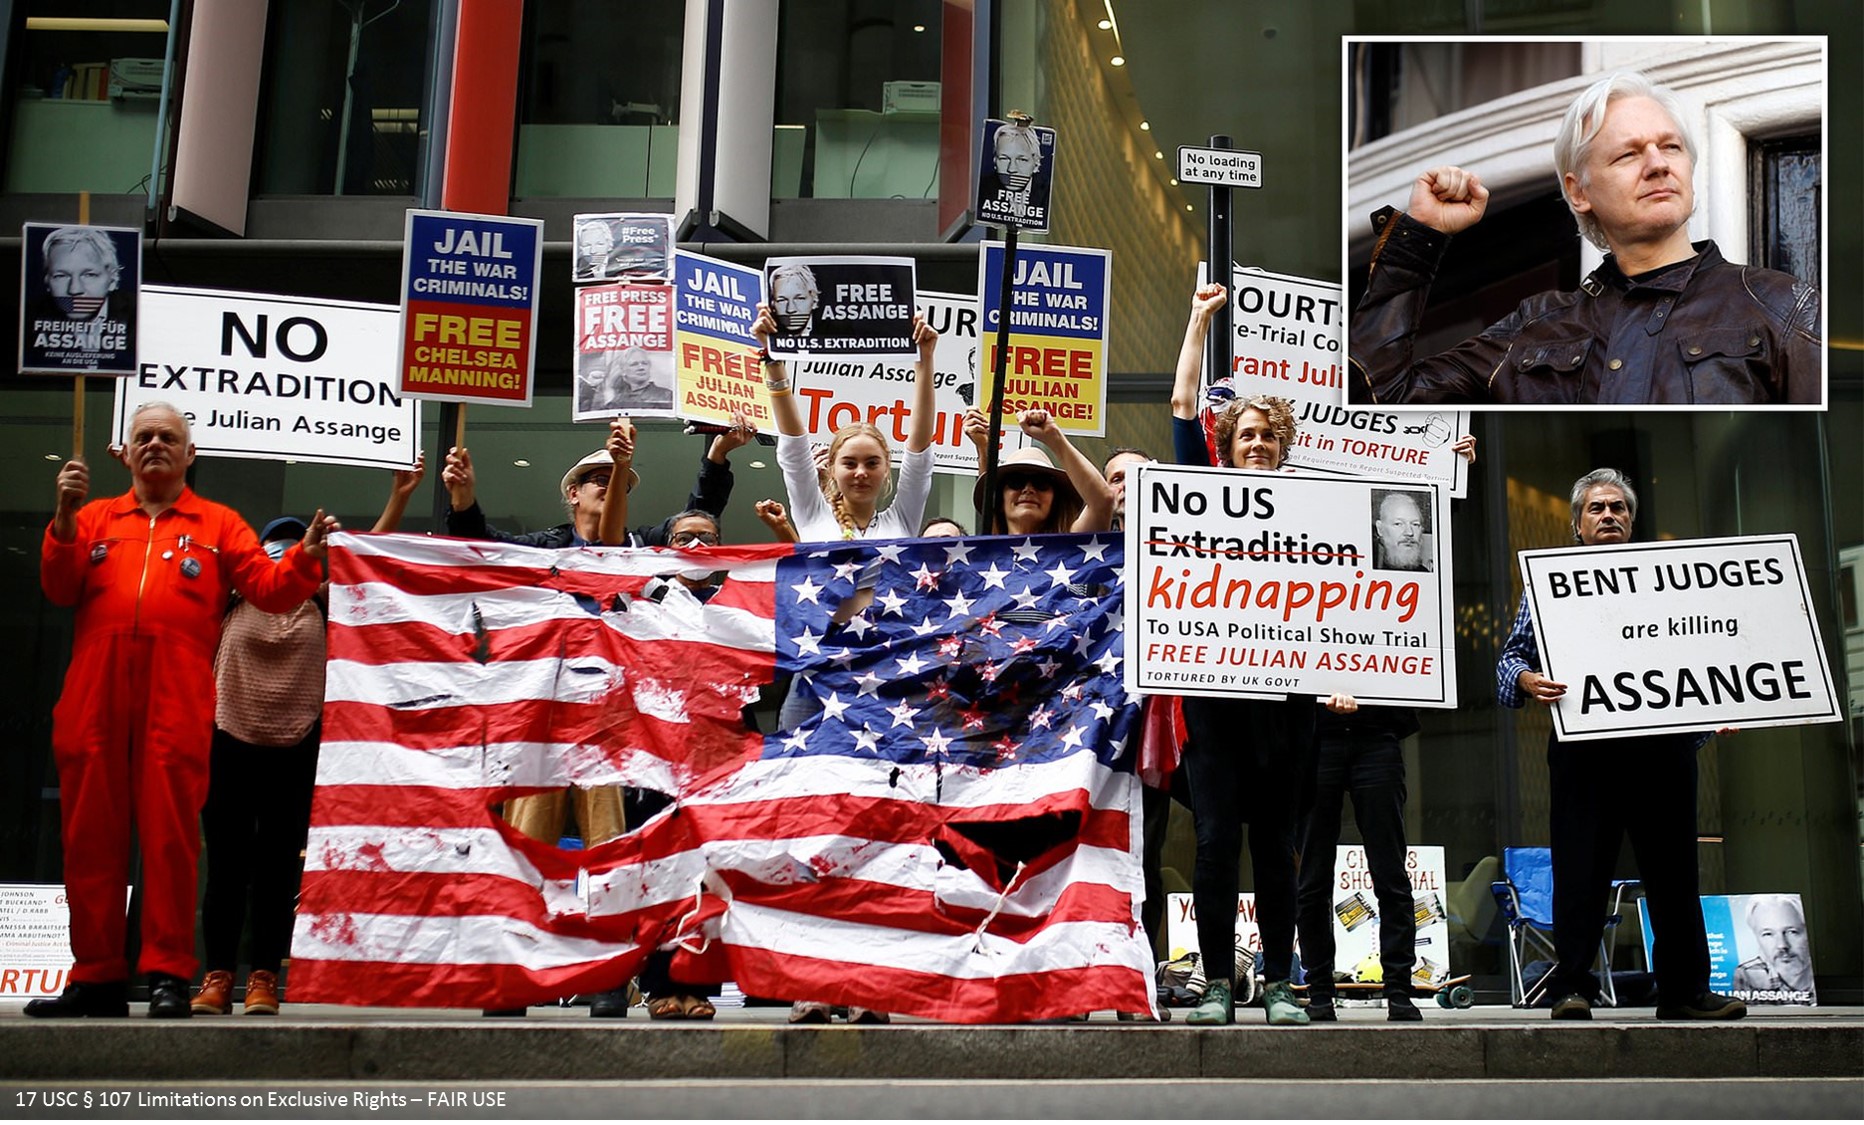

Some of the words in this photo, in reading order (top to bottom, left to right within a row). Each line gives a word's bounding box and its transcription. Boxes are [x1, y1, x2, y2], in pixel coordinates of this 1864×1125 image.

[1187, 153, 1205, 164] No
[1210, 155, 1256, 170] loading
[1185, 167, 1198, 176] at
[1202, 170, 1224, 180] any
[1229, 170, 1256, 182] time
[982, 200, 1044, 218] ASSANGE
[998, 190, 1030, 204] FREE
[622, 227, 656, 235] #Free
[1004, 216, 1043, 226] EXTRADITION
[434, 228, 512, 259] JAIL
[428, 258, 467, 275] THE
[473, 262, 517, 280] WAR
[1013, 260, 1083, 290] JAIL
[413, 278, 528, 300] CRIMINALS!
[688, 268, 746, 302] JAIL
[836, 284, 892, 302] FREE
[585, 291, 618, 305] FREE
[621, 290, 667, 303] PRESS
[684, 294, 716, 312] THE
[718, 302, 752, 322] WAR
[1012, 292, 1039, 306] HE
[1045, 293, 1088, 310] WAR
[1233, 285, 1342, 327] OURT
[585, 304, 667, 335] FREE
[822, 304, 909, 320] ASSANGE
[917, 305, 976, 338] UR
[34, 320, 95, 333] FREIHEIT
[100, 320, 126, 334] FÜR
[221, 311, 328, 362] NO
[414, 313, 522, 349] FREE
[1234, 324, 1305, 346] e-Trial
[34, 333, 126, 350] ASSANGE
[585, 334, 667, 350] ASSANGE
[776, 338, 794, 348] NO
[798, 338, 822, 348] U.S.
[824, 338, 910, 348] EXTRADITION
[414, 346, 518, 369] CHELSEA
[682, 342, 763, 384] FREE
[138, 363, 402, 408] EXTRADITION
[408, 366, 520, 390] MANNING!
[803, 361, 864, 378] Julian
[869, 362, 958, 388] Assage
[1298, 361, 1342, 388] Juli
[696, 376, 755, 399] JULIAN
[1003, 379, 1079, 398] JULIAN
[686, 391, 768, 420] ASSANGE!
[207, 410, 280, 431] Julian
[292, 416, 400, 444] Assange
[1300, 402, 1398, 434] JUDGES
[955, 454, 979, 462] Suspect
[1317, 434, 1334, 451] in
[1342, 438, 1430, 466] TORTURE
[1302, 456, 1347, 468] Requirement
[1359, 464, 1383, 474] Report
[1385, 468, 1422, 479] Suspected
[1152, 482, 1208, 516] No
[1223, 486, 1275, 520] US
[1150, 526, 1358, 567] Extradition
[1548, 566, 1639, 599] BENT
[1654, 558, 1784, 592] JUDGES
[1148, 563, 1420, 622] kidnapping
[1146, 619, 1170, 636] To
[1178, 620, 1220, 638] USA
[1228, 623, 1312, 642] Political
[1320, 626, 1375, 646] Show
[1382, 630, 1428, 648] Trial
[1622, 620, 1660, 640] are
[1668, 616, 1739, 637] killing
[1147, 644, 1208, 664] FREE
[1216, 646, 1307, 670] JULIAN
[1316, 652, 1434, 676] ASSANGE
[1146, 672, 1216, 684] TORTURED
[1220, 675, 1237, 684] BY
[1242, 676, 1260, 686] UK
[1264, 677, 1300, 688] GOVT
[1580, 660, 1812, 715] ASSANGE
[1340, 871, 1374, 890] SHO
[1752, 990, 1810, 1000] ASSANGE
